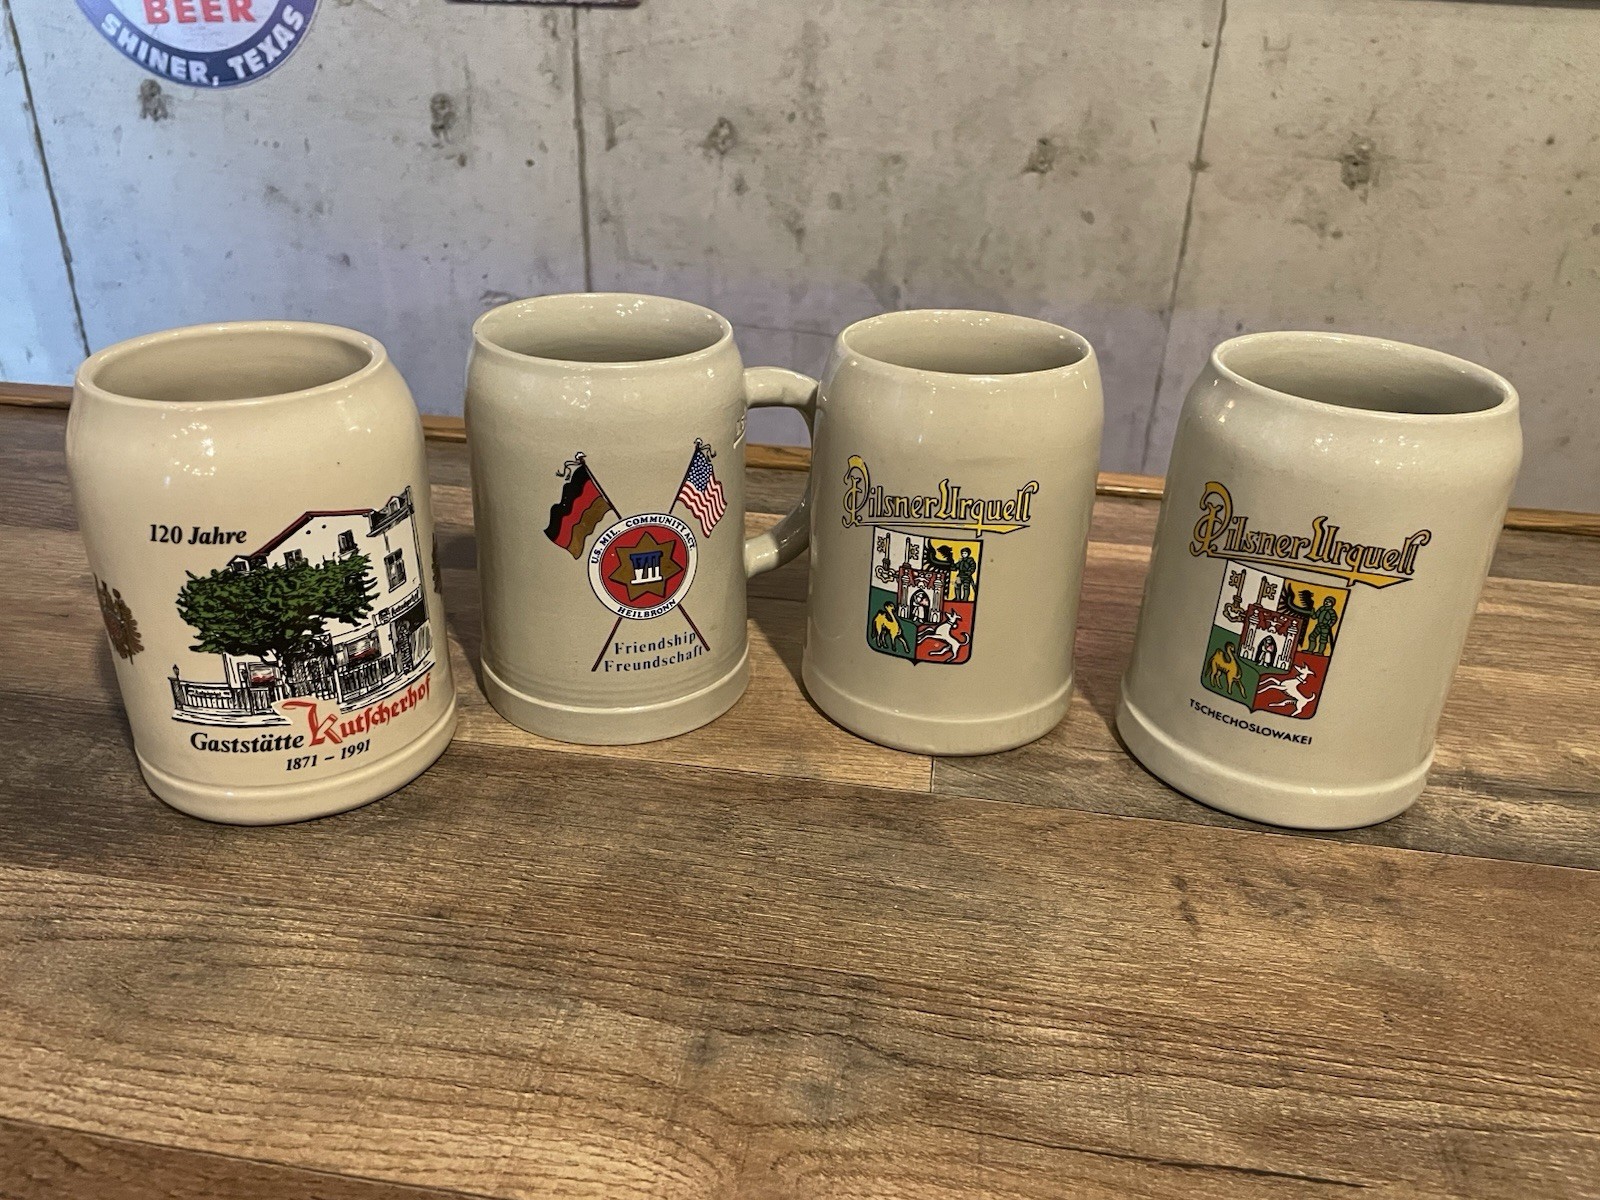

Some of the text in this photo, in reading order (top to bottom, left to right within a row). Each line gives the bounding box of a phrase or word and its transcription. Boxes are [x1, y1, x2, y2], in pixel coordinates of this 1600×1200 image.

[143, 0, 256, 24] BEER
[101, 5, 304, 86] SHINER, TEXAS
[842, 454, 1040, 538] Pilsner Urquell
[149, 524, 247, 545] 120 Jahre
[591, 516, 696, 564] U.S. MIL. COMMUNITY ACT.
[1189, 480, 1432, 587] Pilsner Urquell
[617, 599, 676, 618] HEILBRONN
[615, 631, 696, 655] Friendship
[604, 645, 703, 672] Freundschaft
[1189, 698, 1313, 745] TSCHECHOSLOWAKEI
[190, 731, 304, 753] Gaststätte
[286, 754, 317, 771] 1871
[340, 739, 371, 760] 1991
